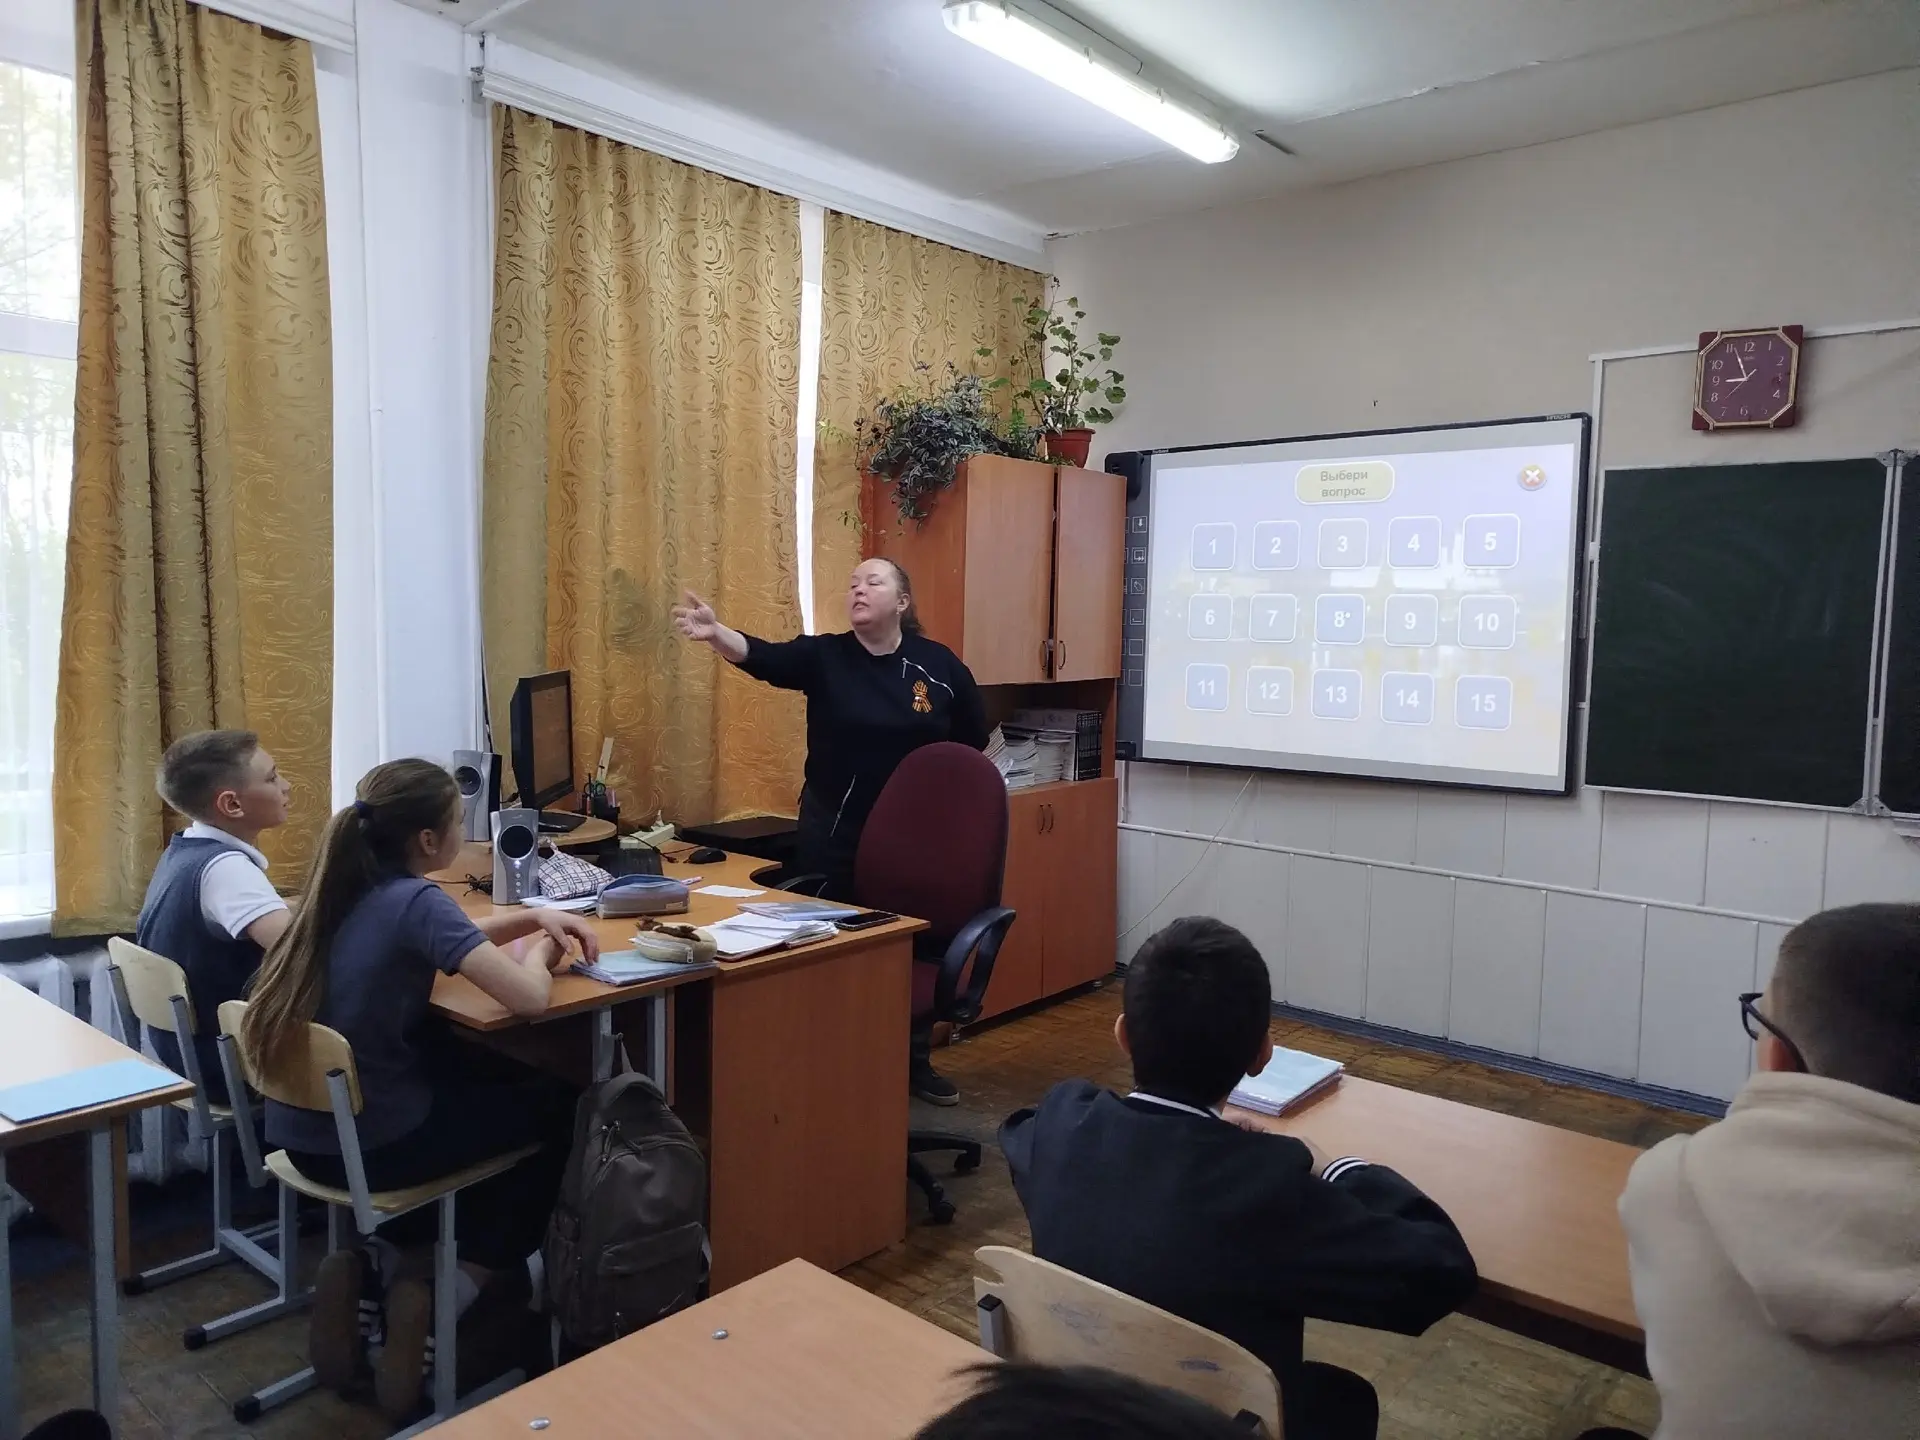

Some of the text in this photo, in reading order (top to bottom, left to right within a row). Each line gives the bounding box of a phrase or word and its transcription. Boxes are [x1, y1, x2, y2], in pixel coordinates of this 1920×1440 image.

[1726, 343, 1734, 353] 11
[1744, 341, 1756, 352] 12
[1711, 360, 1724, 370] 10
[1776, 356, 1784, 366] 2
[1712, 376, 1720, 386] 9
[1711, 392, 1718, 402] 8
[1772, 389, 1780, 399] 4
[1721, 406, 1728, 417] 7
[1320, 470, 1368, 482] Выбери
[1321, 486, 1366, 498] вопрос
[1208, 532, 1496, 556] 1 2 3 4 5
[1205, 610, 1500, 631] 6 7 8 9 10
[1198, 680, 1496, 713] 11 12 13 14 15
